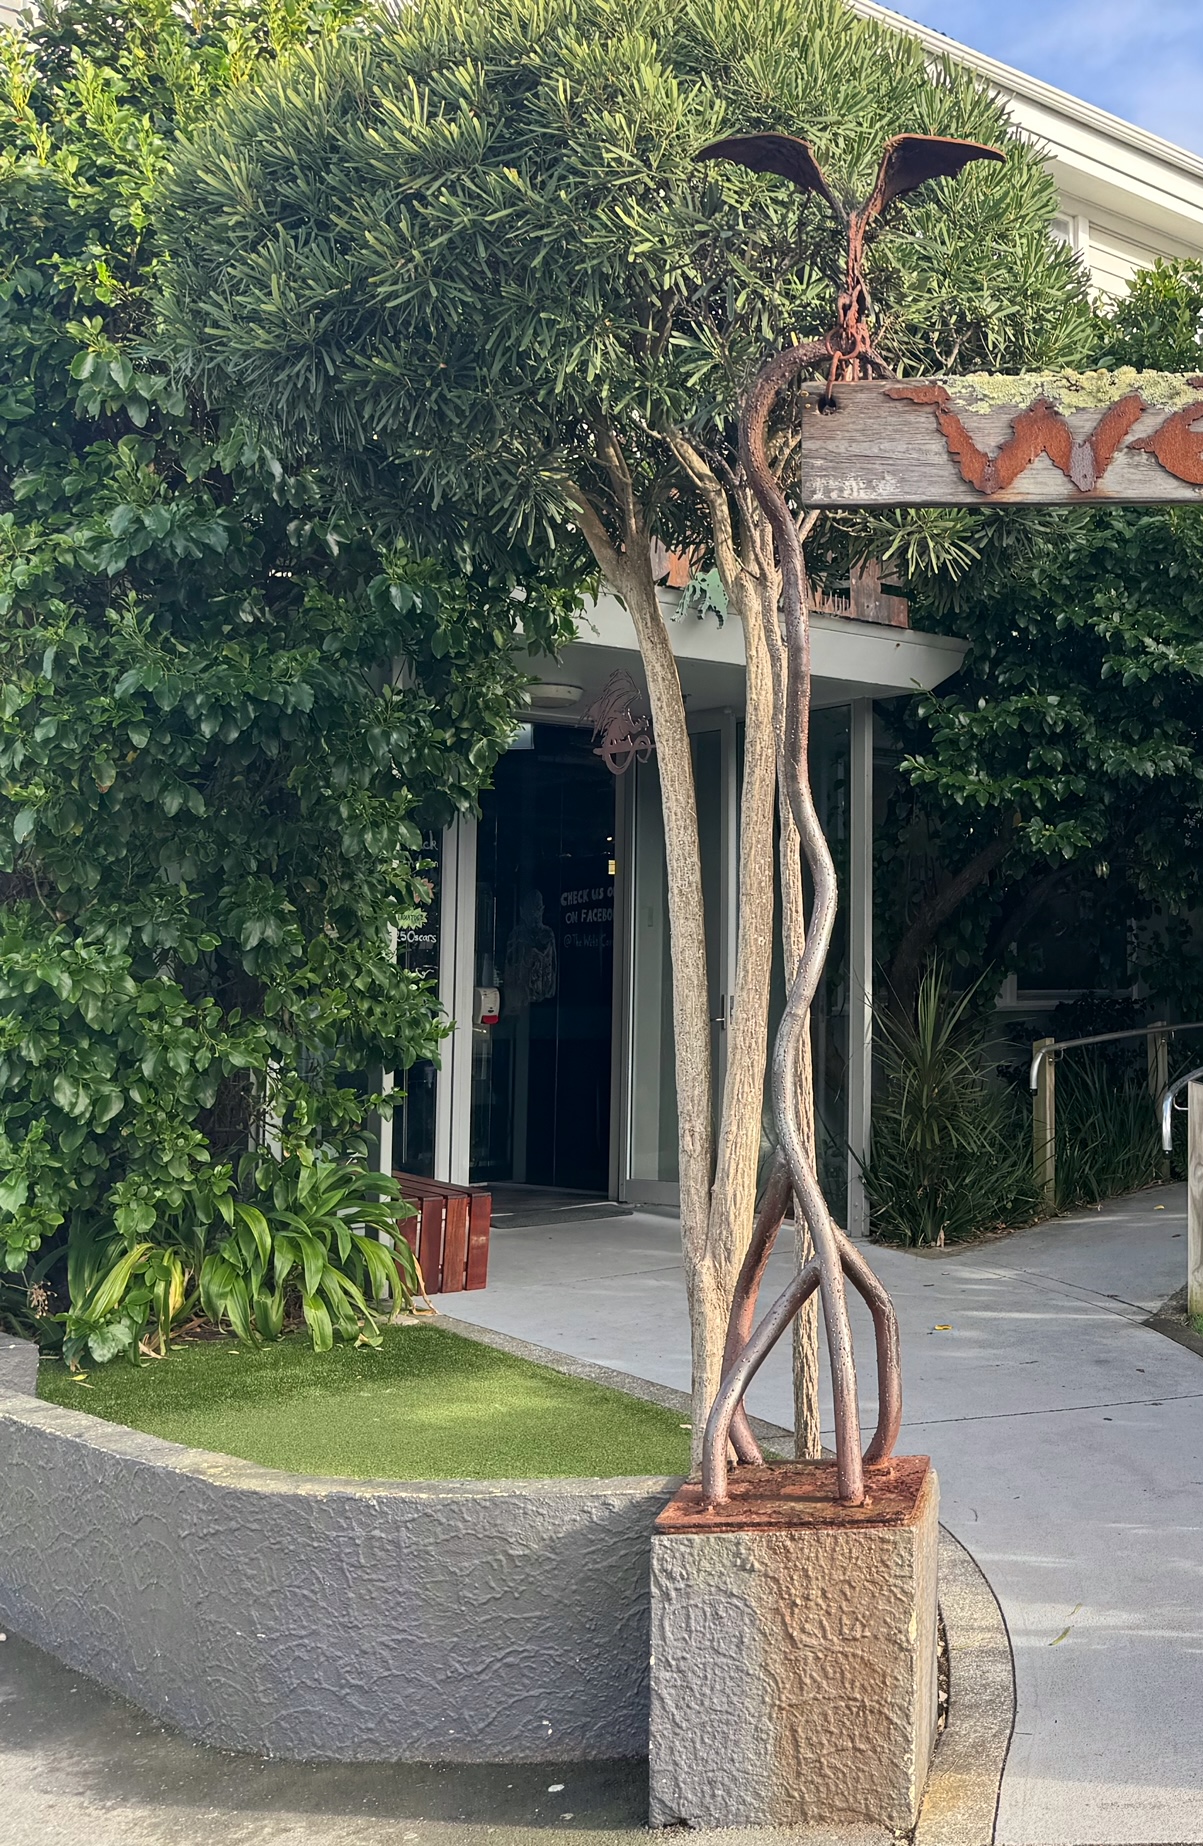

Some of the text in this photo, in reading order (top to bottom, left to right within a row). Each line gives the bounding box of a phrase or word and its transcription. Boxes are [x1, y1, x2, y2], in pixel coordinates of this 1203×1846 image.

[560, 889, 589, 906] CHECK
[591, 888, 604, 900] US
[565, 908, 613, 924] ON FACEBO
